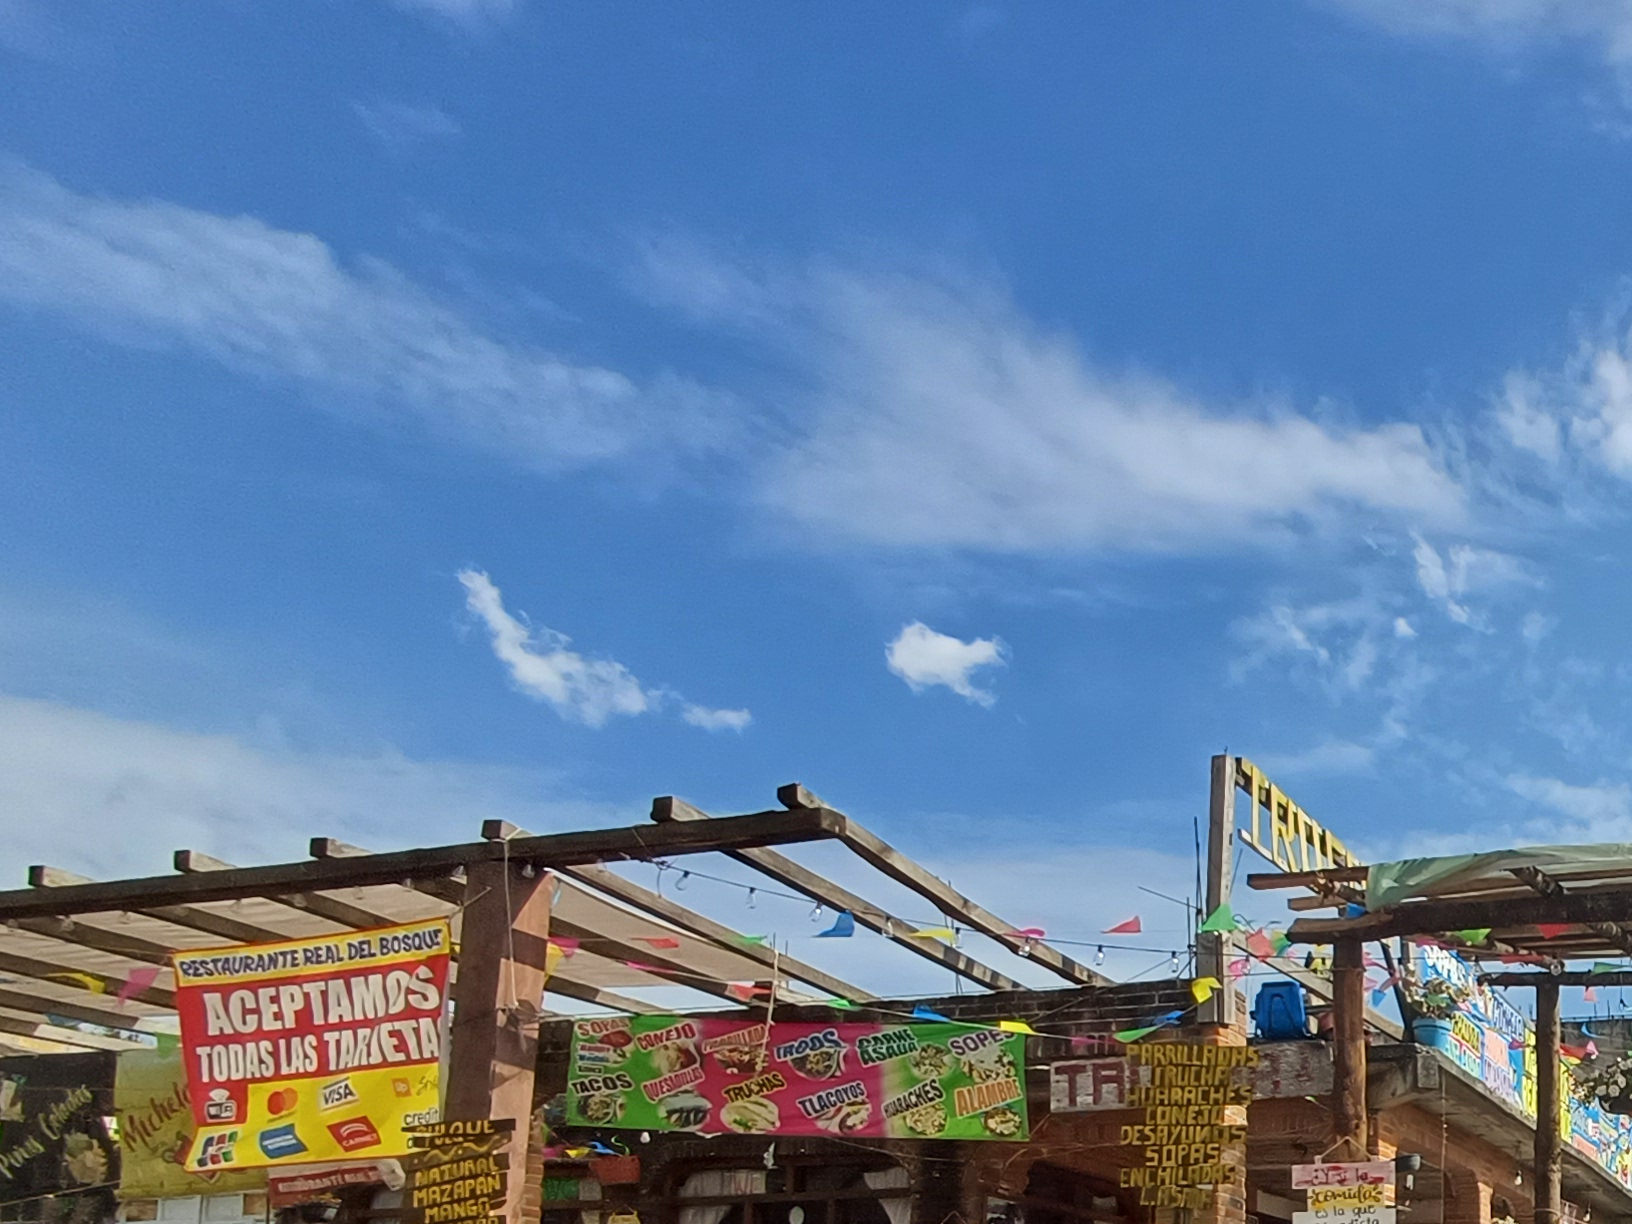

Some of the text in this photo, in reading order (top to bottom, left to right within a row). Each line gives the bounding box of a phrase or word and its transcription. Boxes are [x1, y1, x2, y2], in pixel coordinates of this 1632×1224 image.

[180, 949, 299, 978] RESTAURANTE
[302, 944, 344, 965] REAL
[348, 937, 376, 960] DEL
[203, 965, 440, 1036] ACEPTAMOS
[196, 1016, 441, 1082] TODAS LAS TARJETA
[637, 1022, 696, 1050] CONEJO
[1126, 1044, 1260, 1067] PARRILLADAS
[323, 1083, 356, 1105] VISA
[571, 1074, 633, 1095] TACOS
[724, 1073, 785, 1103] TRUCHAS
[955, 1079, 1022, 1116] ALAMBRE
[799, 1082, 865, 1117] TLACOYOS
[883, 1079, 944, 1119] HUARACHES
[1146, 1105, 1225, 1126] CONEJO
[1120, 1125, 1247, 1146] DESAYUNOS
[1145, 1143, 1220, 1166] SOPAS
[415, 1156, 499, 1187] NATURAL
[1120, 1163, 1236, 1188] ENCHILADAS
[425, 1197, 490, 1224] MANGO
[1333, 1205, 1345, 1216] la
[1352, 1205, 1376, 1218] que
